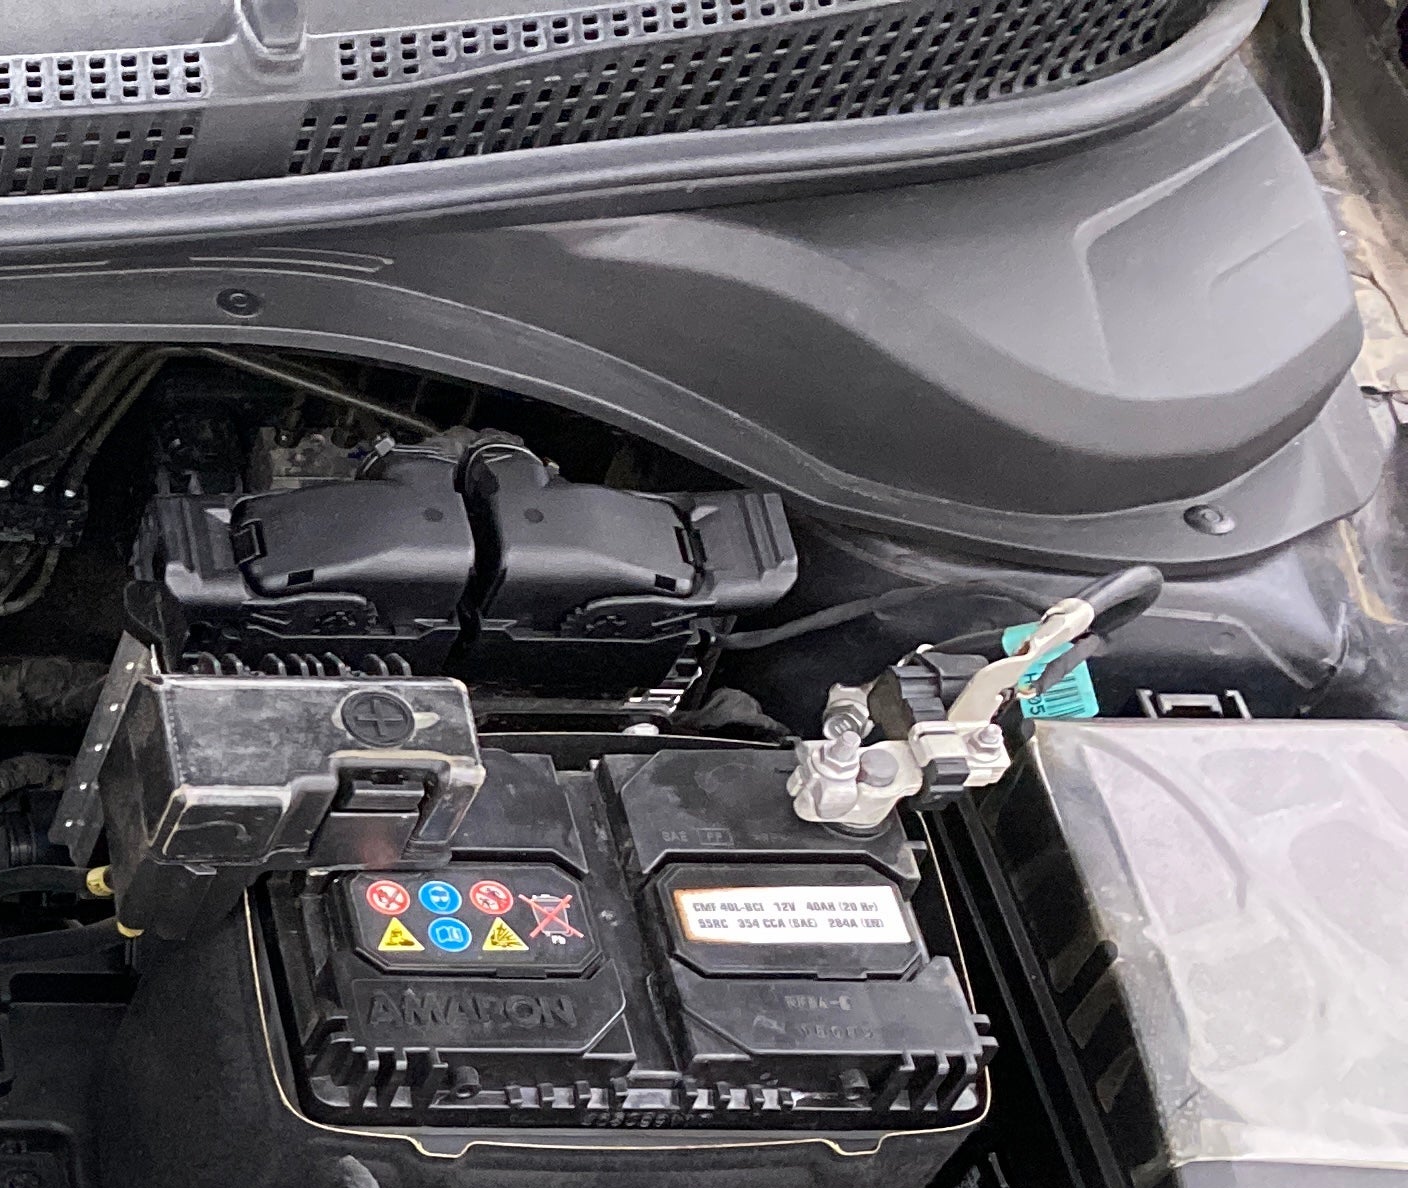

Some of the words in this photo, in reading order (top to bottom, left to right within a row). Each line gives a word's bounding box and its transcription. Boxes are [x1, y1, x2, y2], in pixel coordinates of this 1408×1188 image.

[692, 902, 716, 912] CMF
[773, 902, 796, 912] 12V
[806, 901, 836, 912] 40AH
[838, 901, 858, 912] (20
[736, 918, 760, 929] 354
[762, 918, 786, 929] CCA
[827, 918, 859, 929] 284A
